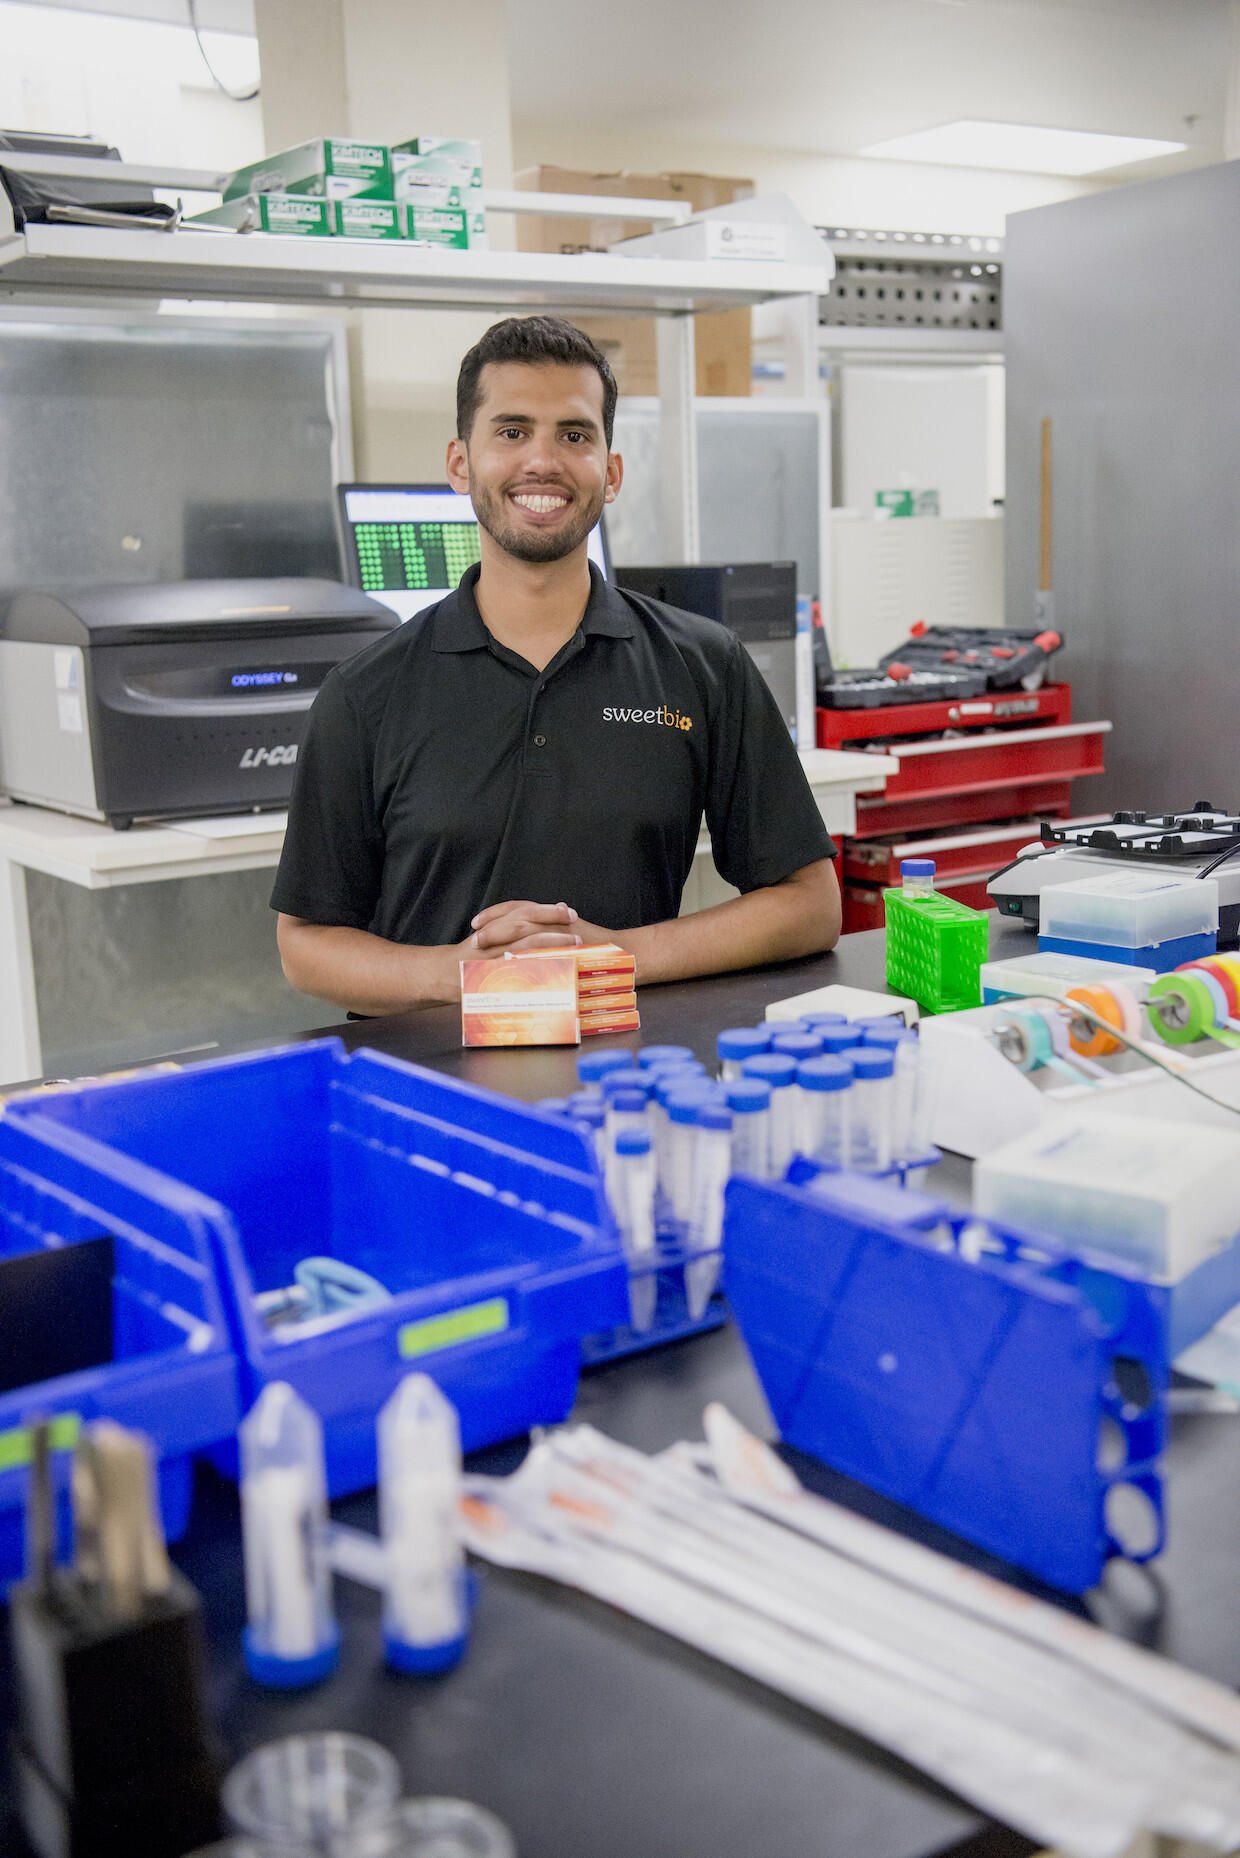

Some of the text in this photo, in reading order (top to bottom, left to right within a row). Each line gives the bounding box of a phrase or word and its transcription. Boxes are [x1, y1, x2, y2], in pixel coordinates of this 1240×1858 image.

[331, 146, 384, 161] KIMTECH
[267, 201, 321, 216] KIMTECH
[341, 206, 394, 221] KIMTECH
[231, 672, 283, 687] ODYSSEY
[602, 705, 693, 731] sweetbio
[239, 744, 298, 768] LI-CO
